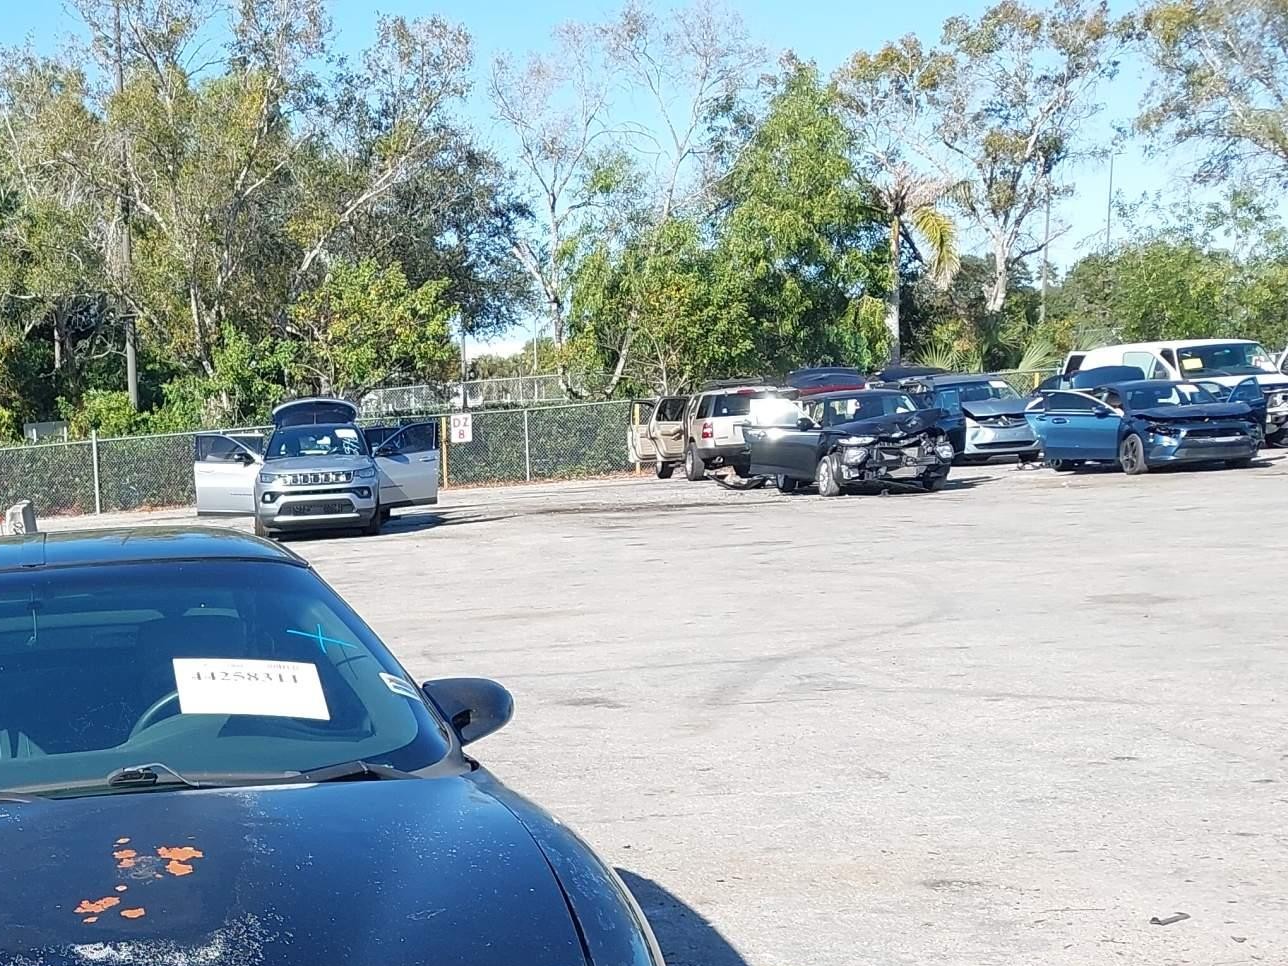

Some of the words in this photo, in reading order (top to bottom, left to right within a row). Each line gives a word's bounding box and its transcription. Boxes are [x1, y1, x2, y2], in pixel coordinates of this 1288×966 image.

[452, 417, 469, 428] DZ
[458, 430, 465, 439] 8
[191, 671, 298, 684] 44258311
